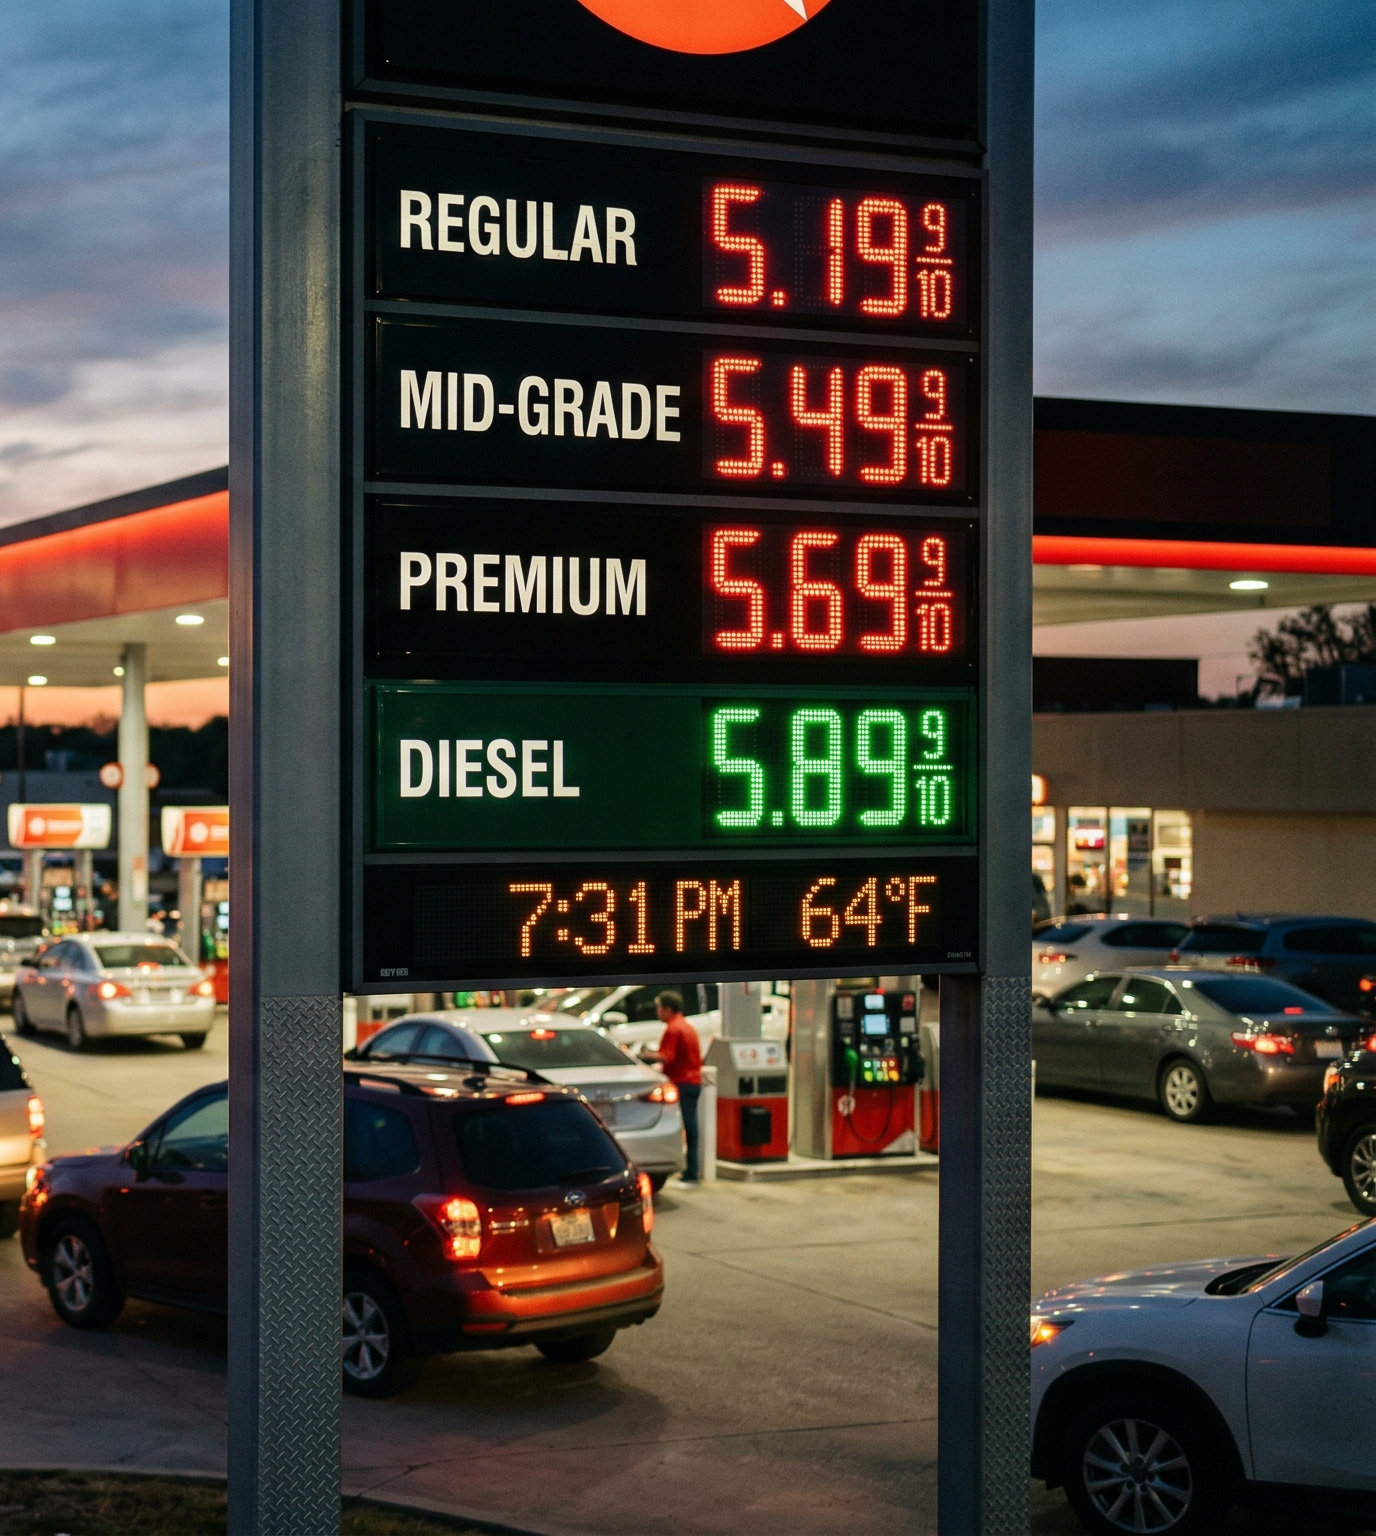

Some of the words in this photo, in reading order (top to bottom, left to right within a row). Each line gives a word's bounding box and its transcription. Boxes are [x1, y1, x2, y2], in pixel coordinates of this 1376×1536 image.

[400, 190, 637, 266] REGULAR
[712, 184, 908, 315] 5.19
[400, 369, 681, 442] MID-GRADE
[712, 357, 908, 484] 5.49
[400, 551, 647, 616] PREMIUM
[712, 530, 908, 651] 5.69
[400, 739, 580, 798] DIESEL
[713, 708, 907, 826] 5.89
[509, 882, 655, 957] 7:31
[676, 880, 740, 952] PM
[802, 876, 937, 947] 64°F
